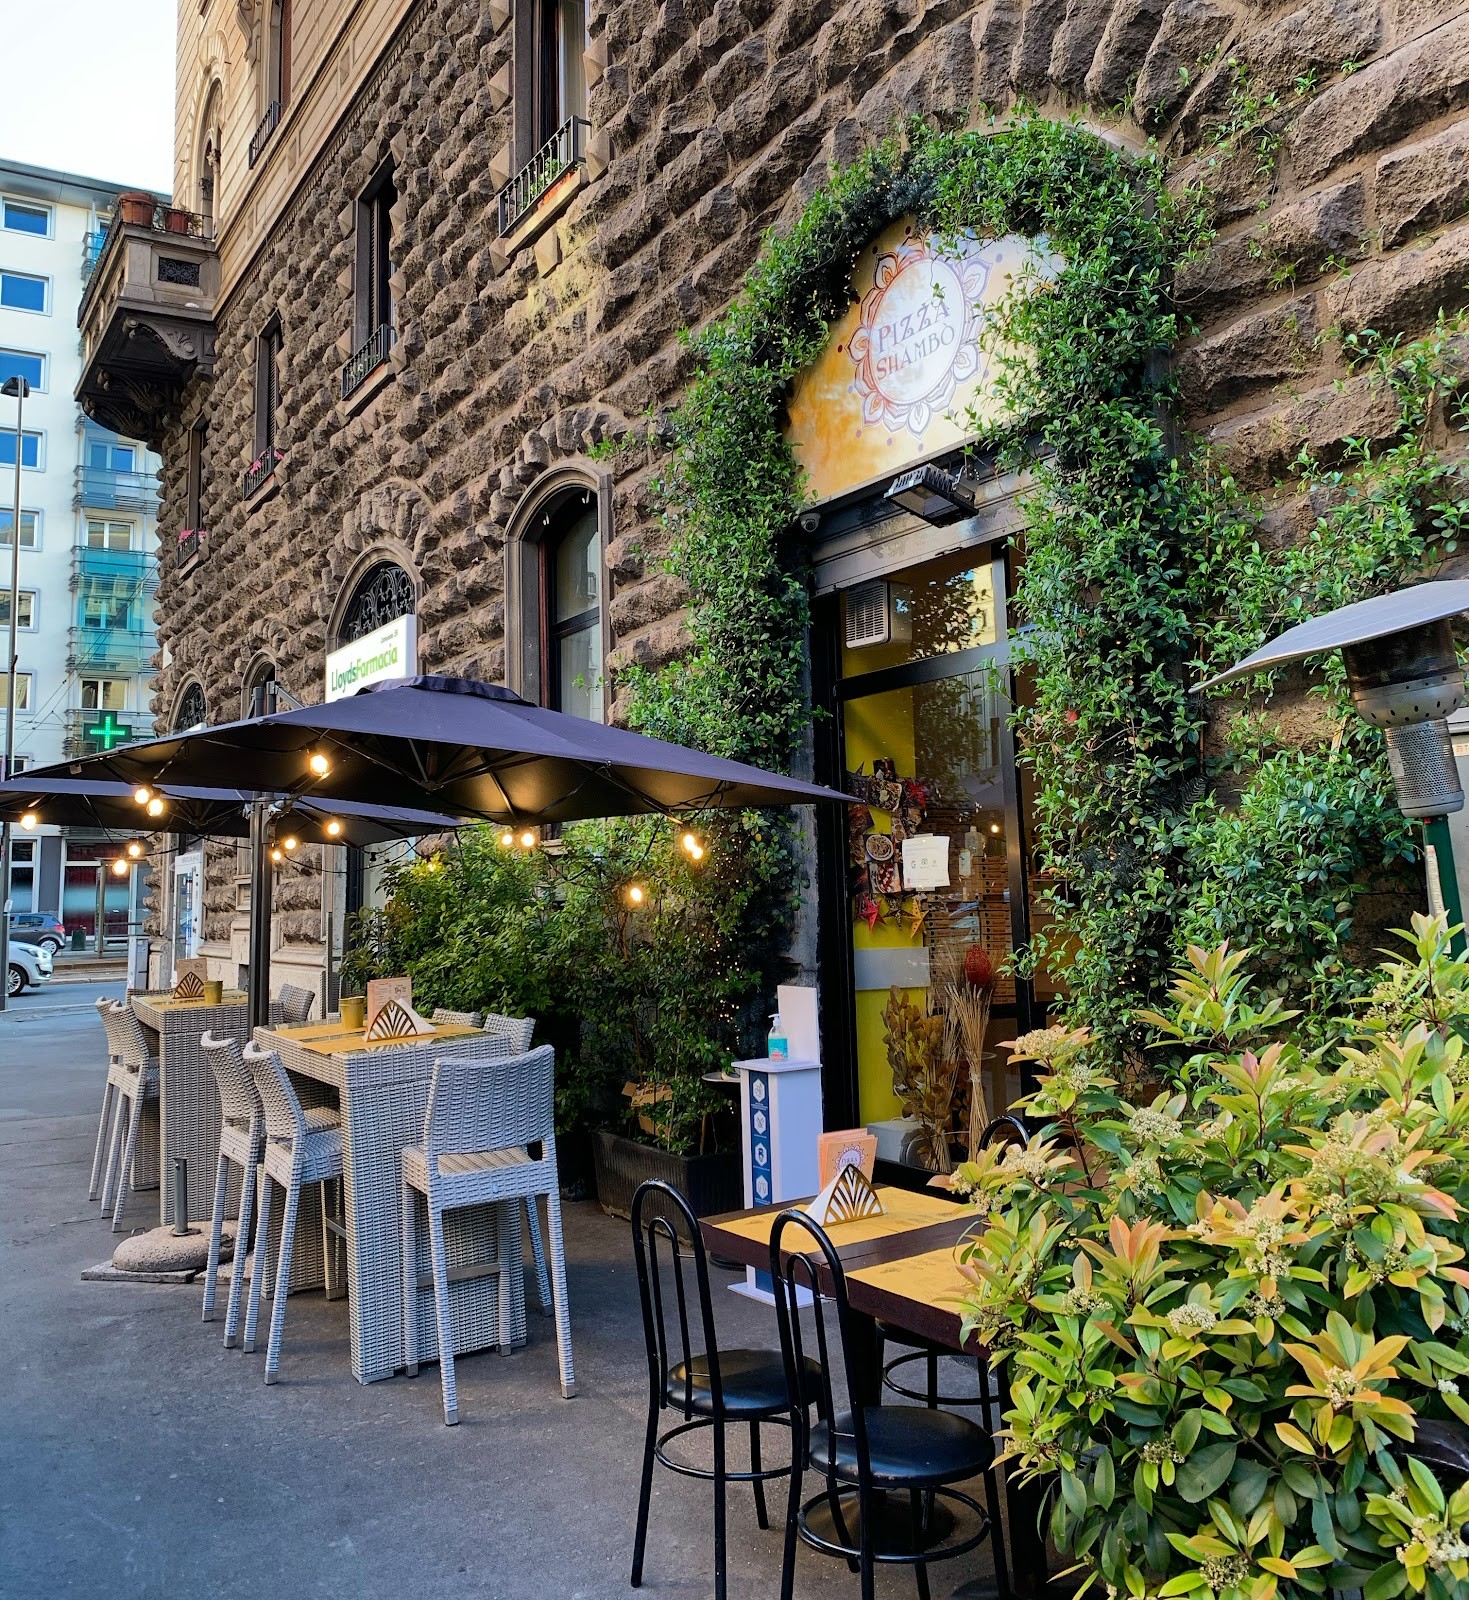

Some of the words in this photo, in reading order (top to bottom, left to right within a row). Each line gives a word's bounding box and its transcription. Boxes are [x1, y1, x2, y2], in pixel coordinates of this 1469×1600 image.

[876, 322, 955, 380] SHAMBÒ
[877, 298, 951, 354] PIZZA
[331, 643, 398, 693] LloydsFarmacia
